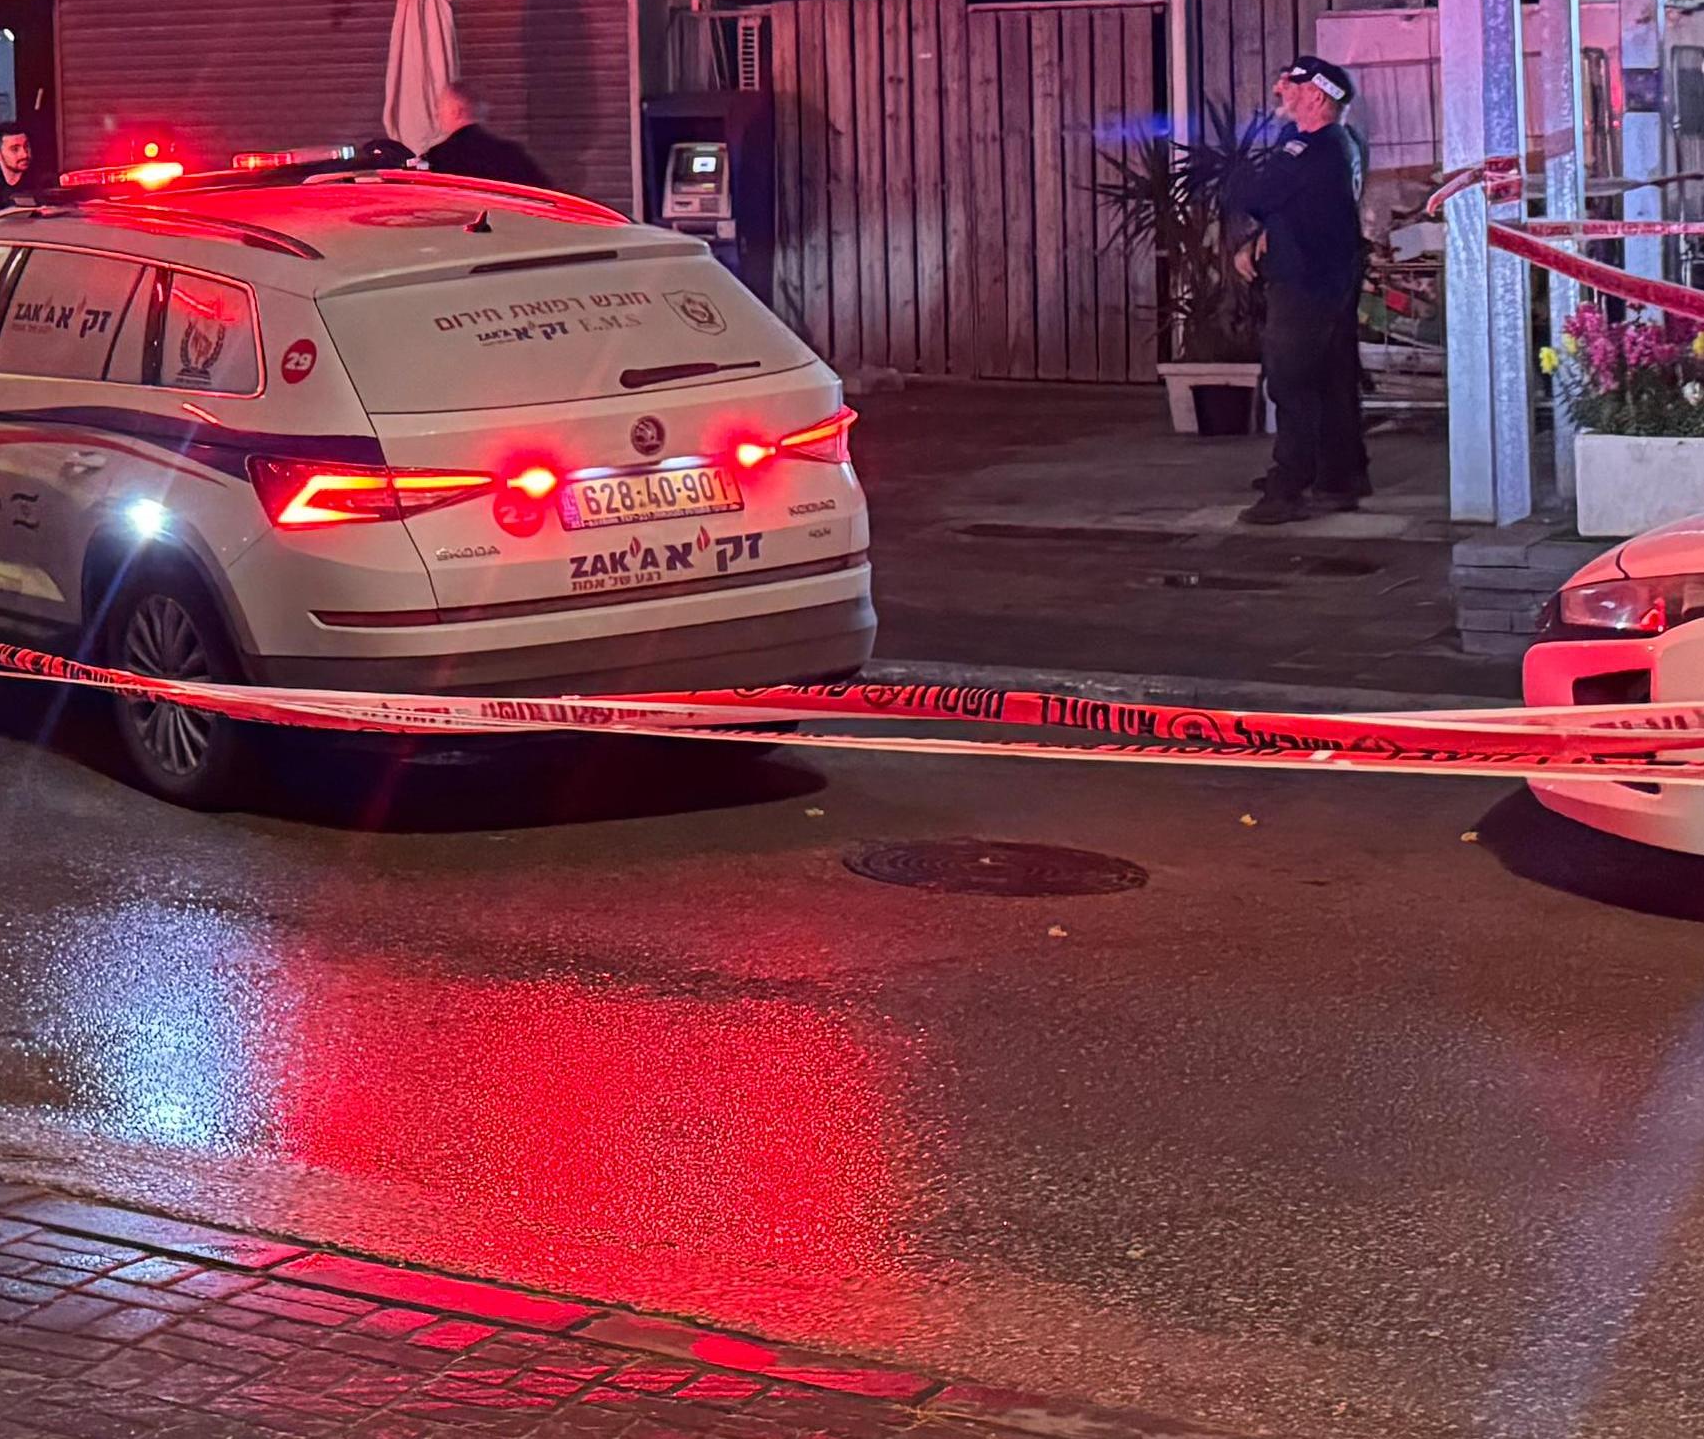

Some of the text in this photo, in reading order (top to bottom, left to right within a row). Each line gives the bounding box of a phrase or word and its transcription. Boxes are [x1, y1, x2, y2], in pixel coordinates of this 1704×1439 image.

[434, 290, 652, 332] חובש רפואת חירום
[284, 351, 310, 372] 29
[571, 571, 661, 592] רגע של אמת
